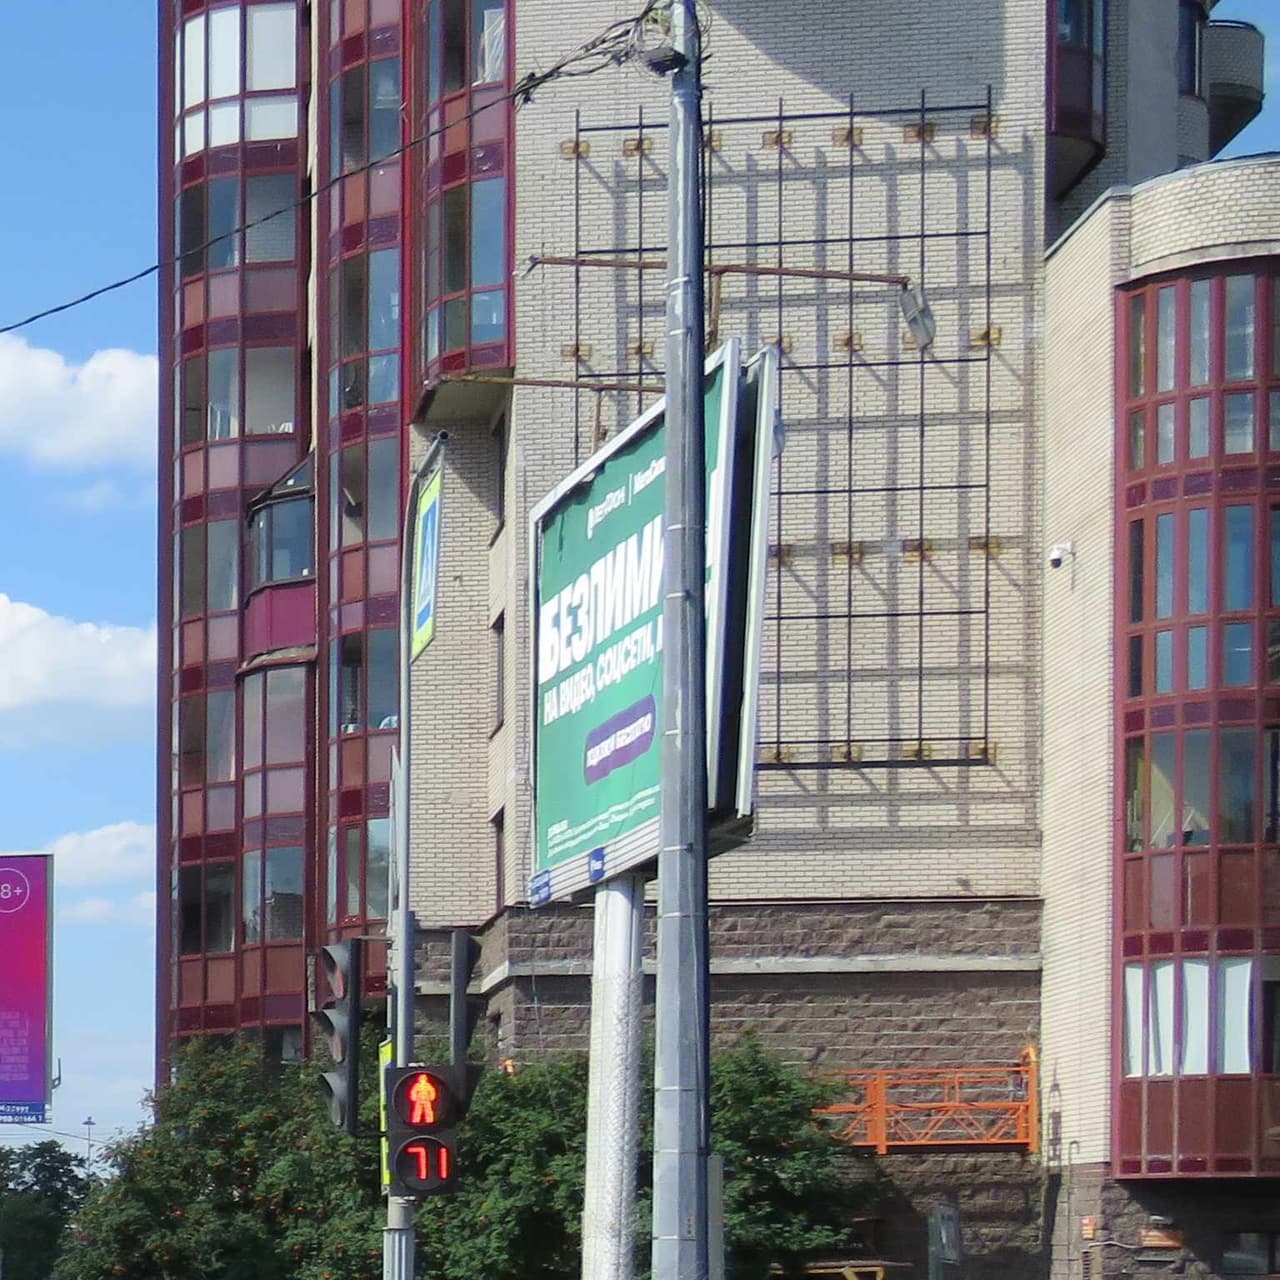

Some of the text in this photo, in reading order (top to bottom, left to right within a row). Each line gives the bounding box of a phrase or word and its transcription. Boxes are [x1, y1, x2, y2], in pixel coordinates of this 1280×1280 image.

[543, 686, 559, 725] НА
[596, 621, 654, 691] СОЦСЕТИ,
[406, 1146, 449, 1180] 71
